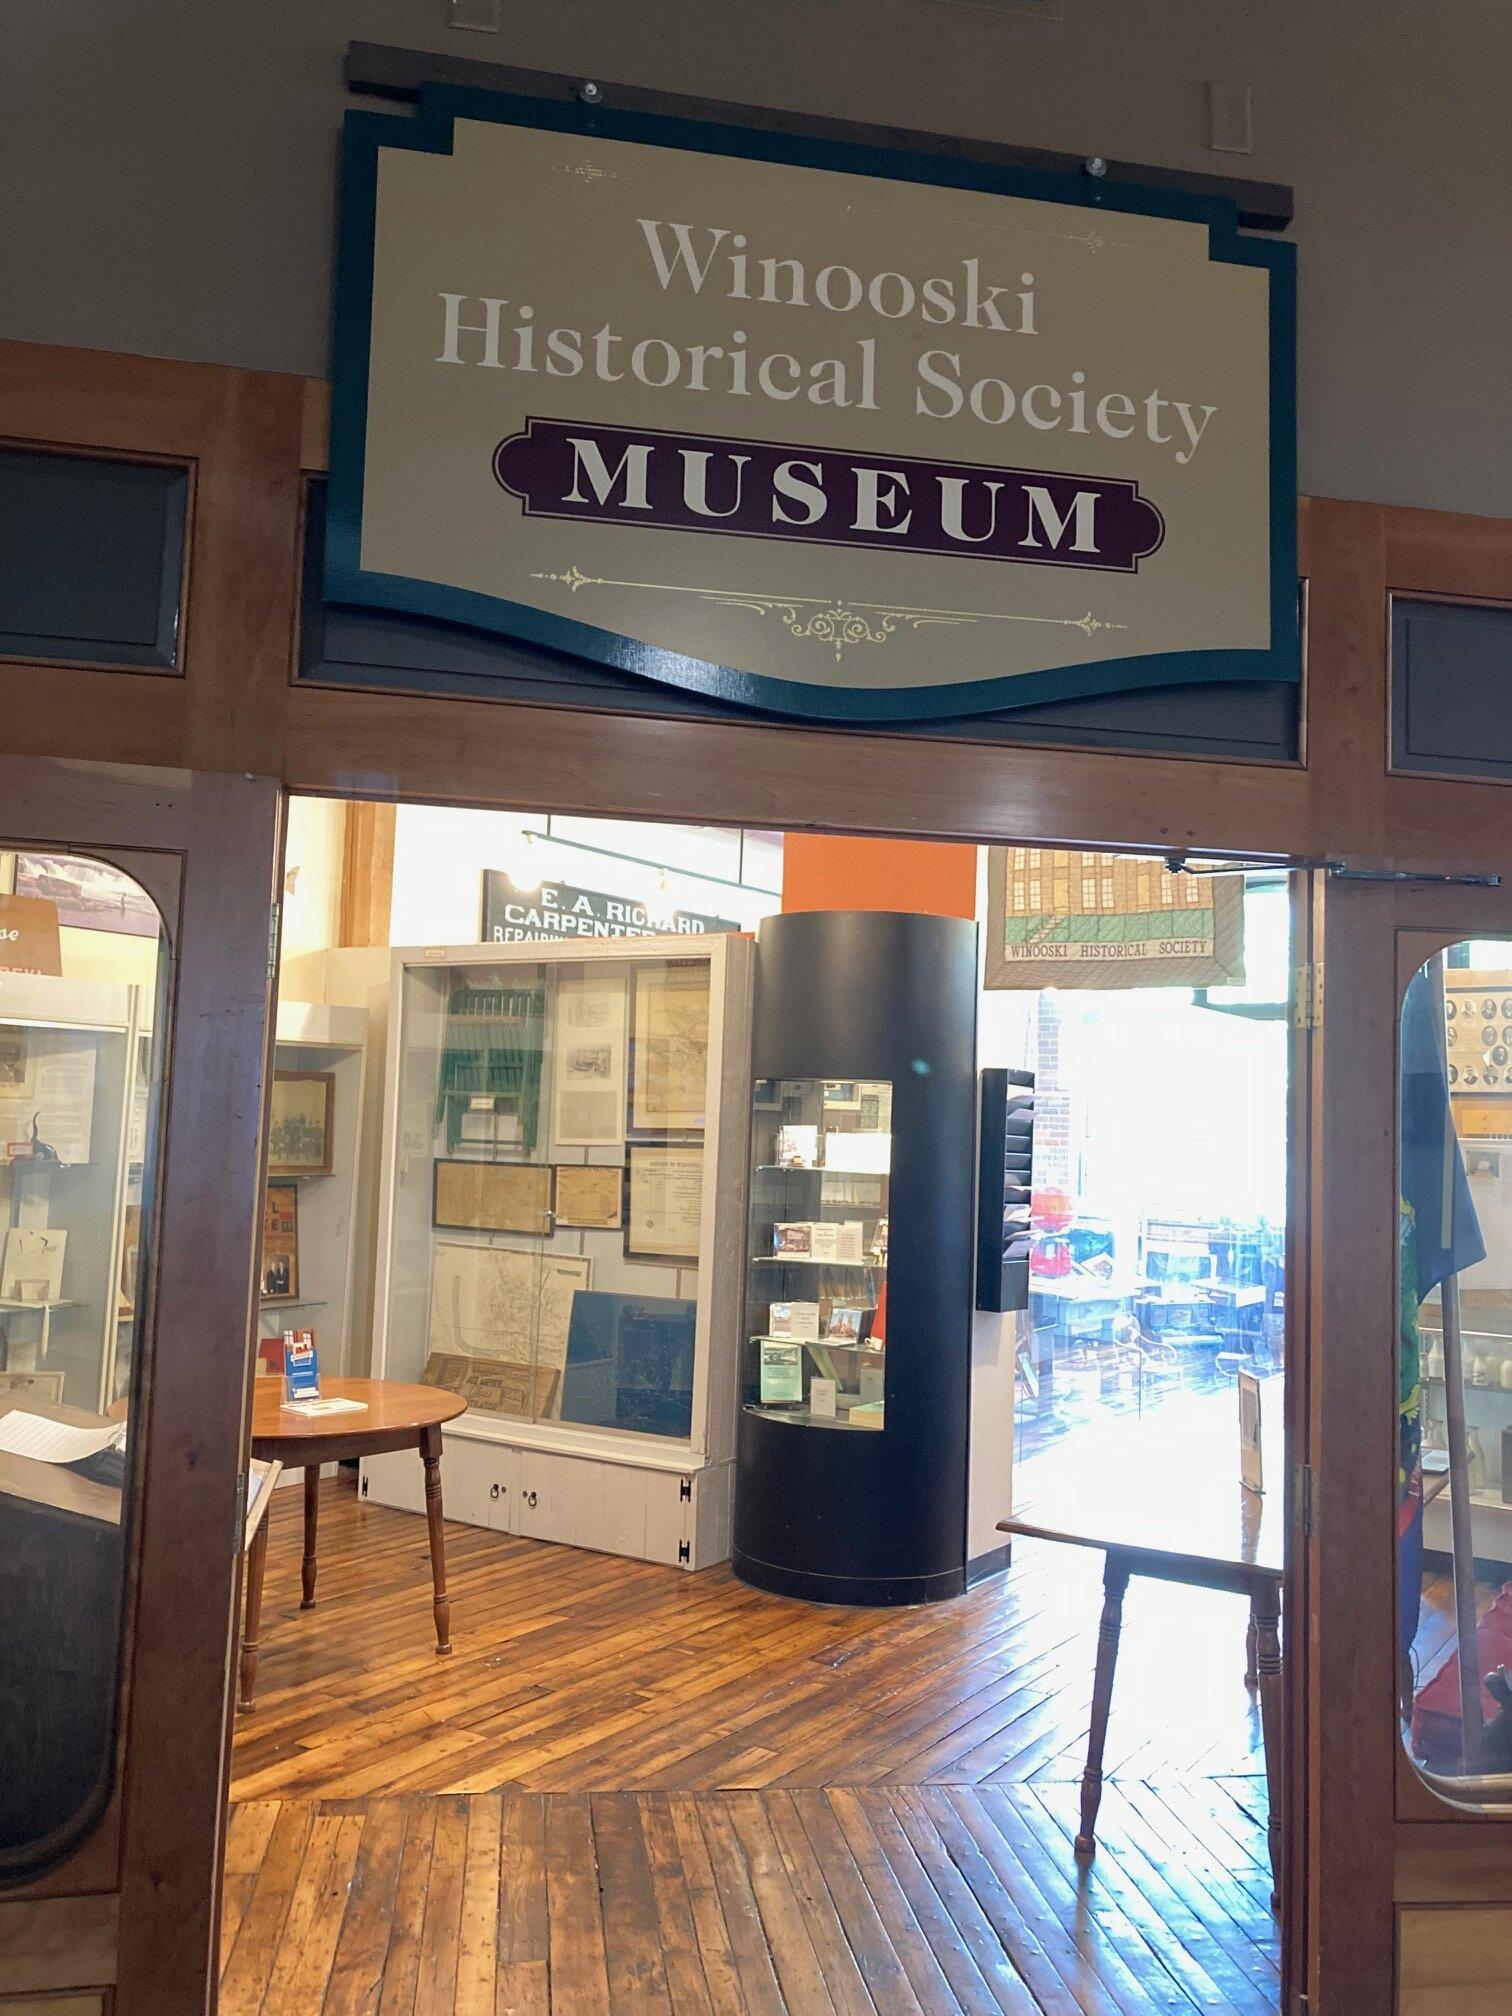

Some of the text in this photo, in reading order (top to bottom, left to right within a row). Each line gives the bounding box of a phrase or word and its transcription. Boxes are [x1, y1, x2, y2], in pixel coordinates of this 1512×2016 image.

[637, 218, 1040, 336] Winooski
[436, 291, 1218, 465] Historical Society
[561, 436, 1102, 555] MUSEUM
[1011, 940, 1208, 959] WINOOSKI HISTORICAL SOCIETY
